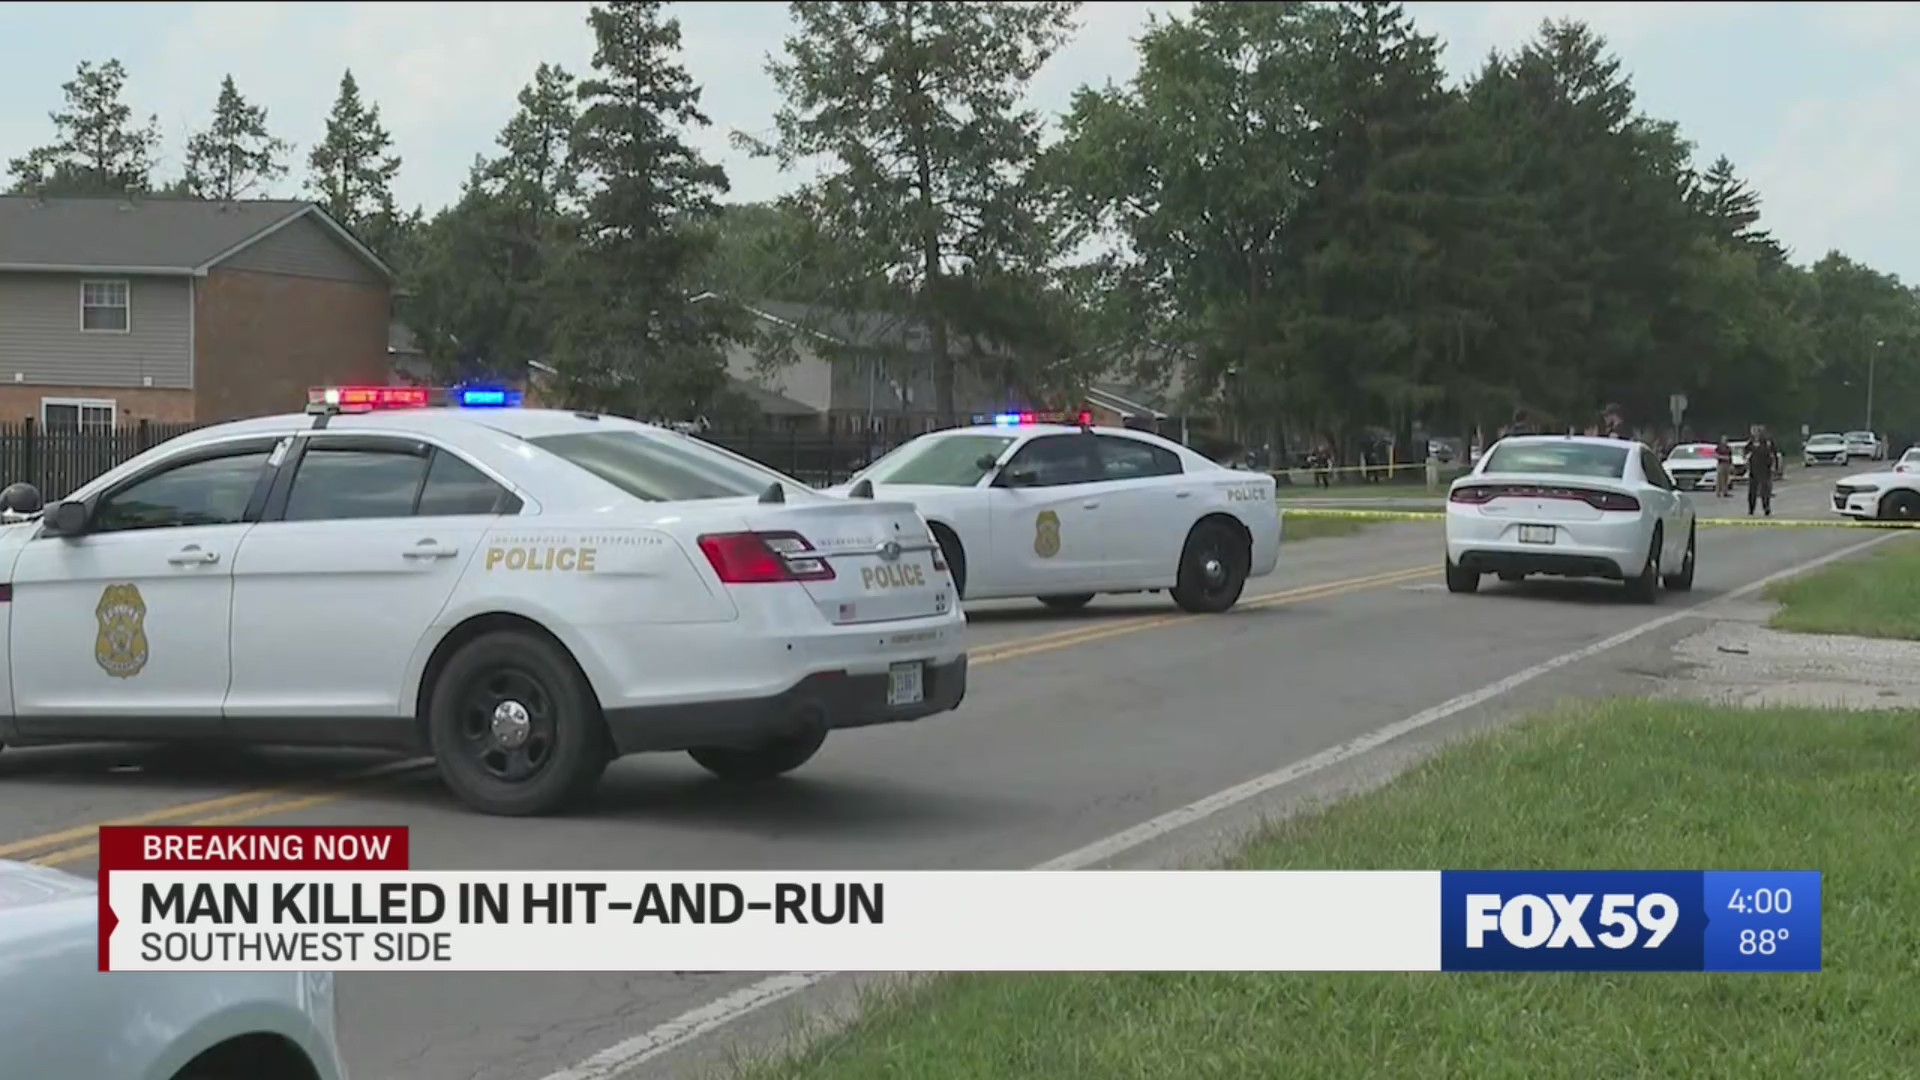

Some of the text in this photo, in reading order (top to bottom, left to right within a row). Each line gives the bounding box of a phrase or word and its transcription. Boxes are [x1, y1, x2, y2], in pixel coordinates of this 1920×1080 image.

[1227, 487, 1267, 501] POLICE
[486, 547, 597, 571] POLICE
[861, 564, 925, 590] POLICE
